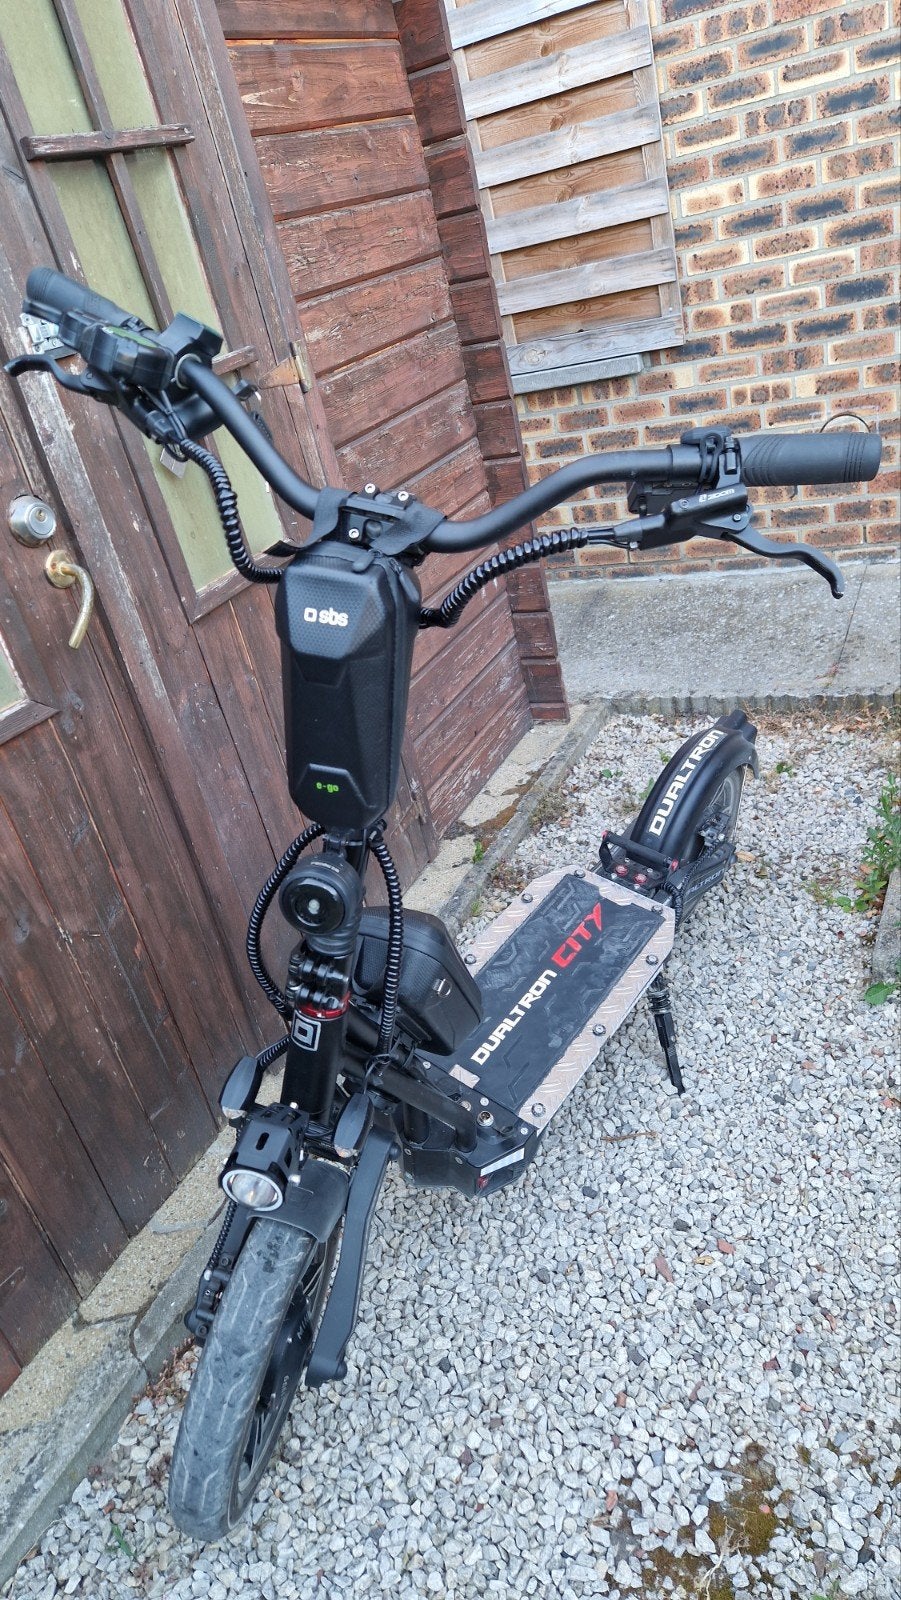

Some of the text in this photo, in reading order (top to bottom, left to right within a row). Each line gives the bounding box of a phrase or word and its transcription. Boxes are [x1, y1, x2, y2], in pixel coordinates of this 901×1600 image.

[319, 607, 349, 627] sbs
[316, 782, 339, 793] e-go
[649, 729, 728, 836] DUALTRON
[471, 902, 602, 1066] DUALTRON CITY
